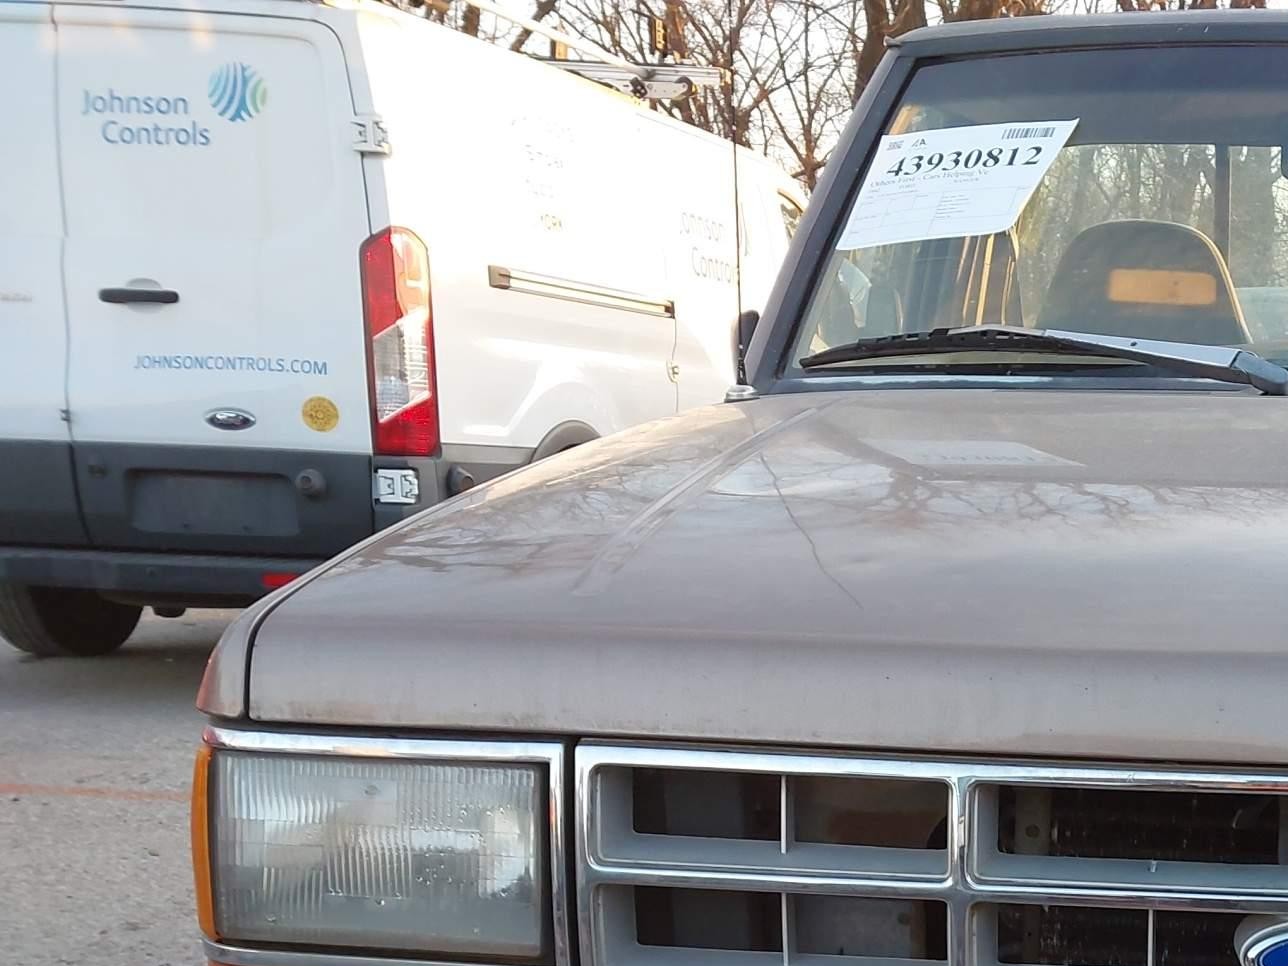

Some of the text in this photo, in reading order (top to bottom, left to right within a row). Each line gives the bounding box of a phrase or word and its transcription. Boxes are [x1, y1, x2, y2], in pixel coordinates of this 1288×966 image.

[81, 88, 189, 115] Johnson
[102, 120, 210, 146] Controls
[887, 146, 1042, 177] 43930812
[133, 354, 328, 376] JOHNSONCONTROLS.COM
